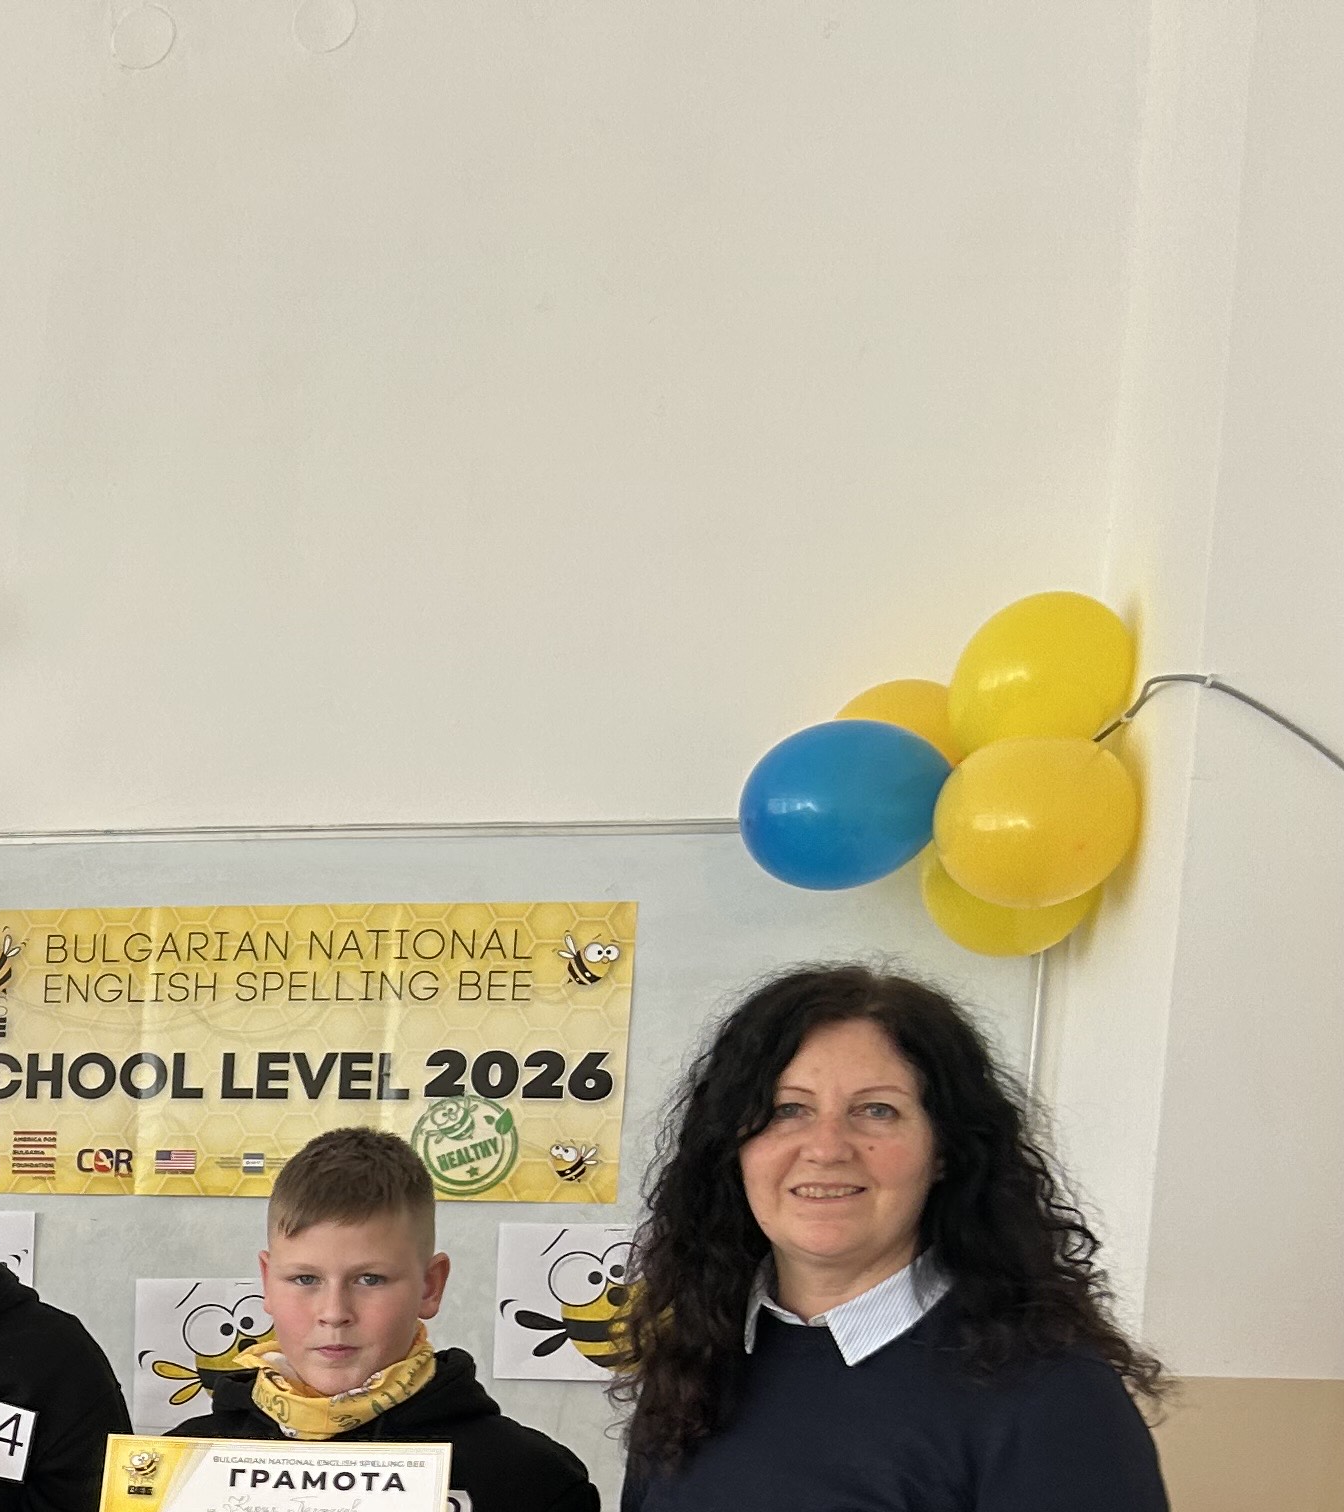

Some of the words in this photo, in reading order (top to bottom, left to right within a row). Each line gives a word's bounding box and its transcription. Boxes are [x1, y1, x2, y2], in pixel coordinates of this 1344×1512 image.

[45, 932, 288, 964] BULGARIAN
[308, 929, 532, 962] NATIONAL
[44, 972, 217, 1003] ENGLISH
[235, 970, 439, 1003] SPELLING
[459, 969, 532, 1002] BEE
[220, 1052, 410, 1100] LEVEL
[424, 1049, 613, 1102] 2026
[436, 1137, 499, 1171] HEALTHY
[229, 1468, 406, 1492] ГРАМОТА
